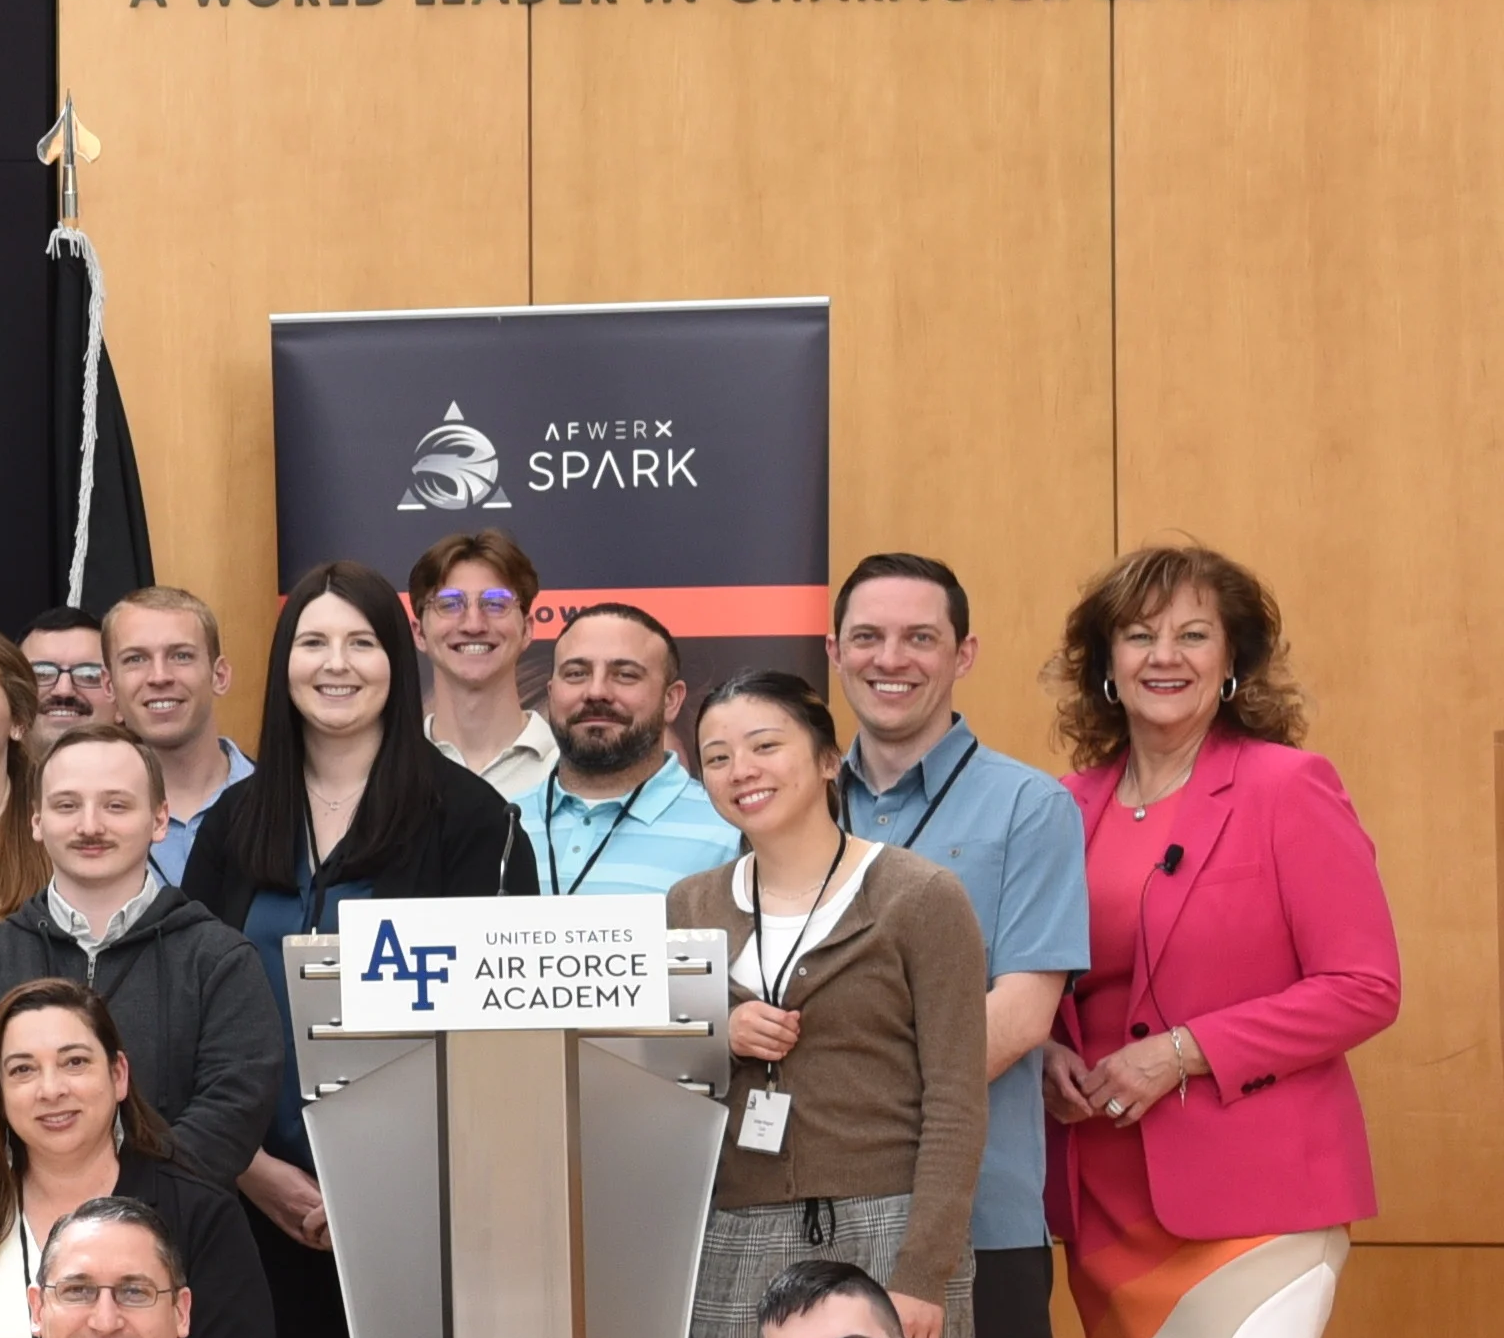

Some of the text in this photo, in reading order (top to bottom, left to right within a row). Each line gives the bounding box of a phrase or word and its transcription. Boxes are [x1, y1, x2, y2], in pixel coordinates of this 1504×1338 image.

[527, 447, 699, 492] SPARK
[486, 928, 634, 946] UNITED STATES
[360, 918, 457, 1011] AF
[474, 953, 648, 980] AIR FORCE
[481, 984, 642, 1011] ACADEMY
